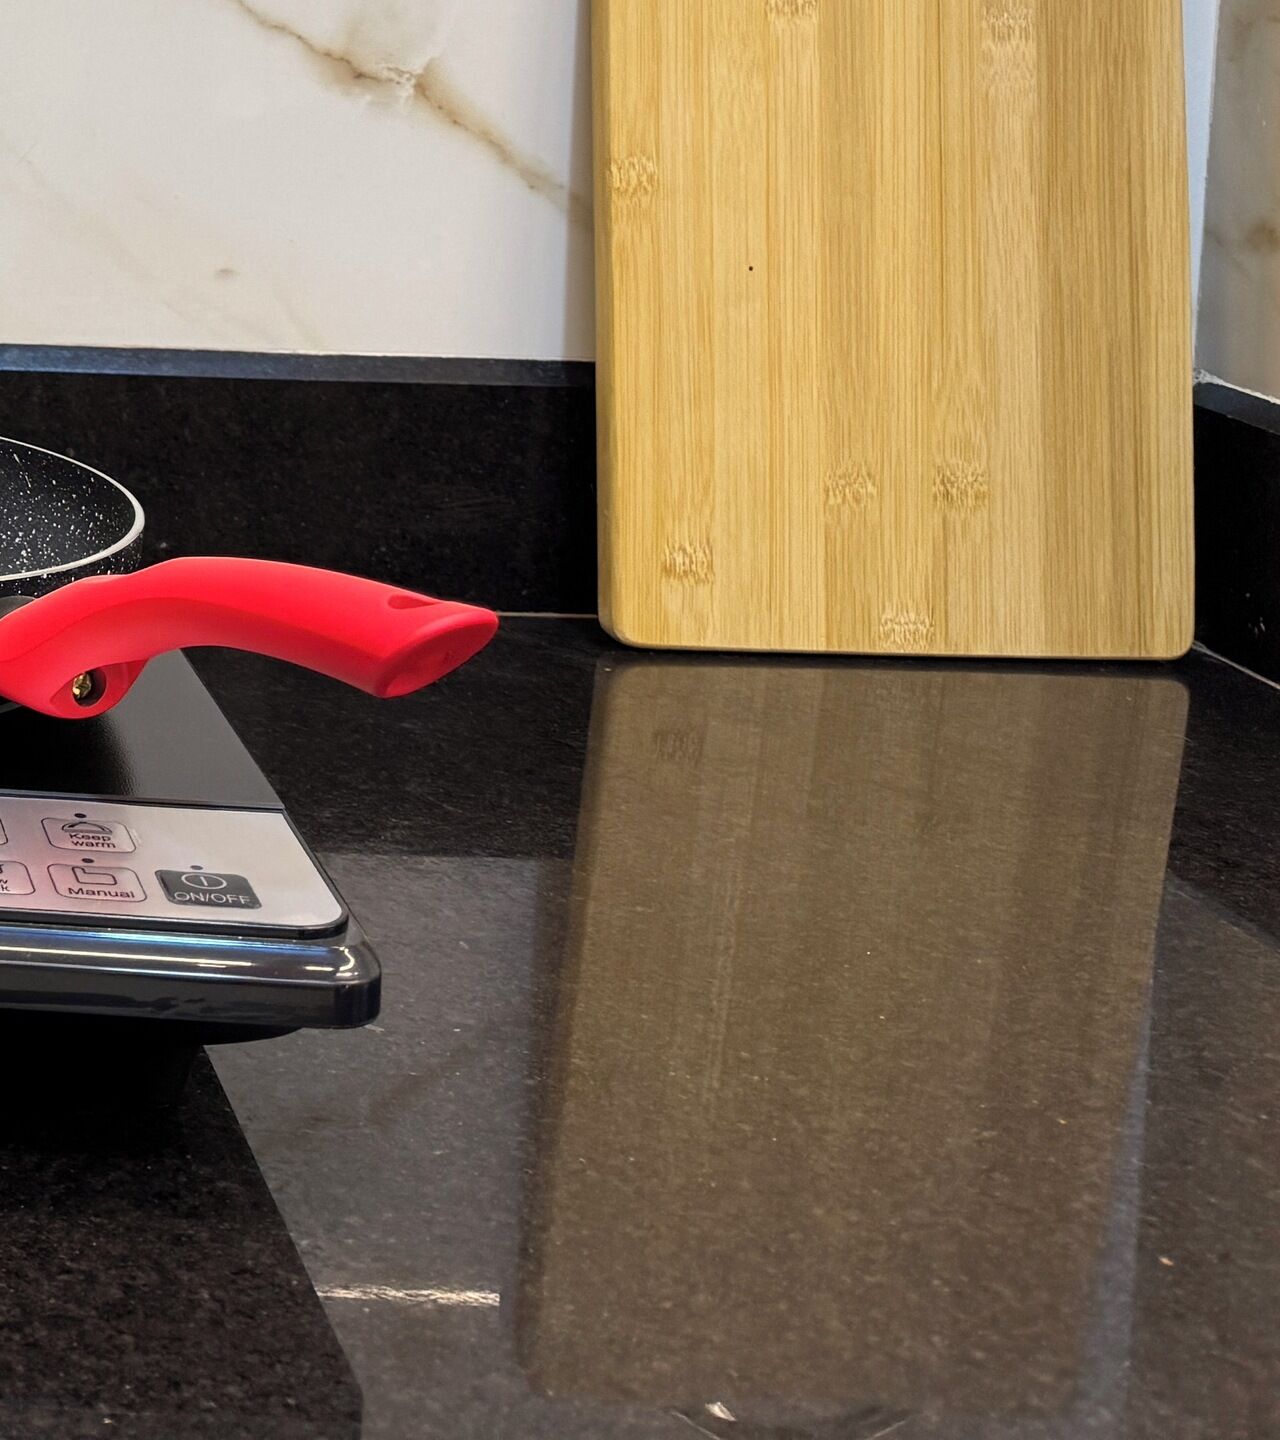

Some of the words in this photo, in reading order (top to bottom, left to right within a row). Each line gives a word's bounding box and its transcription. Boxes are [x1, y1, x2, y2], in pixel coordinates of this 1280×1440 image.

[69, 832, 112, 842] Keep
[71, 841, 116, 849] warm
[68, 887, 135, 899] Manual
[174, 891, 251, 905] ON/OFF
